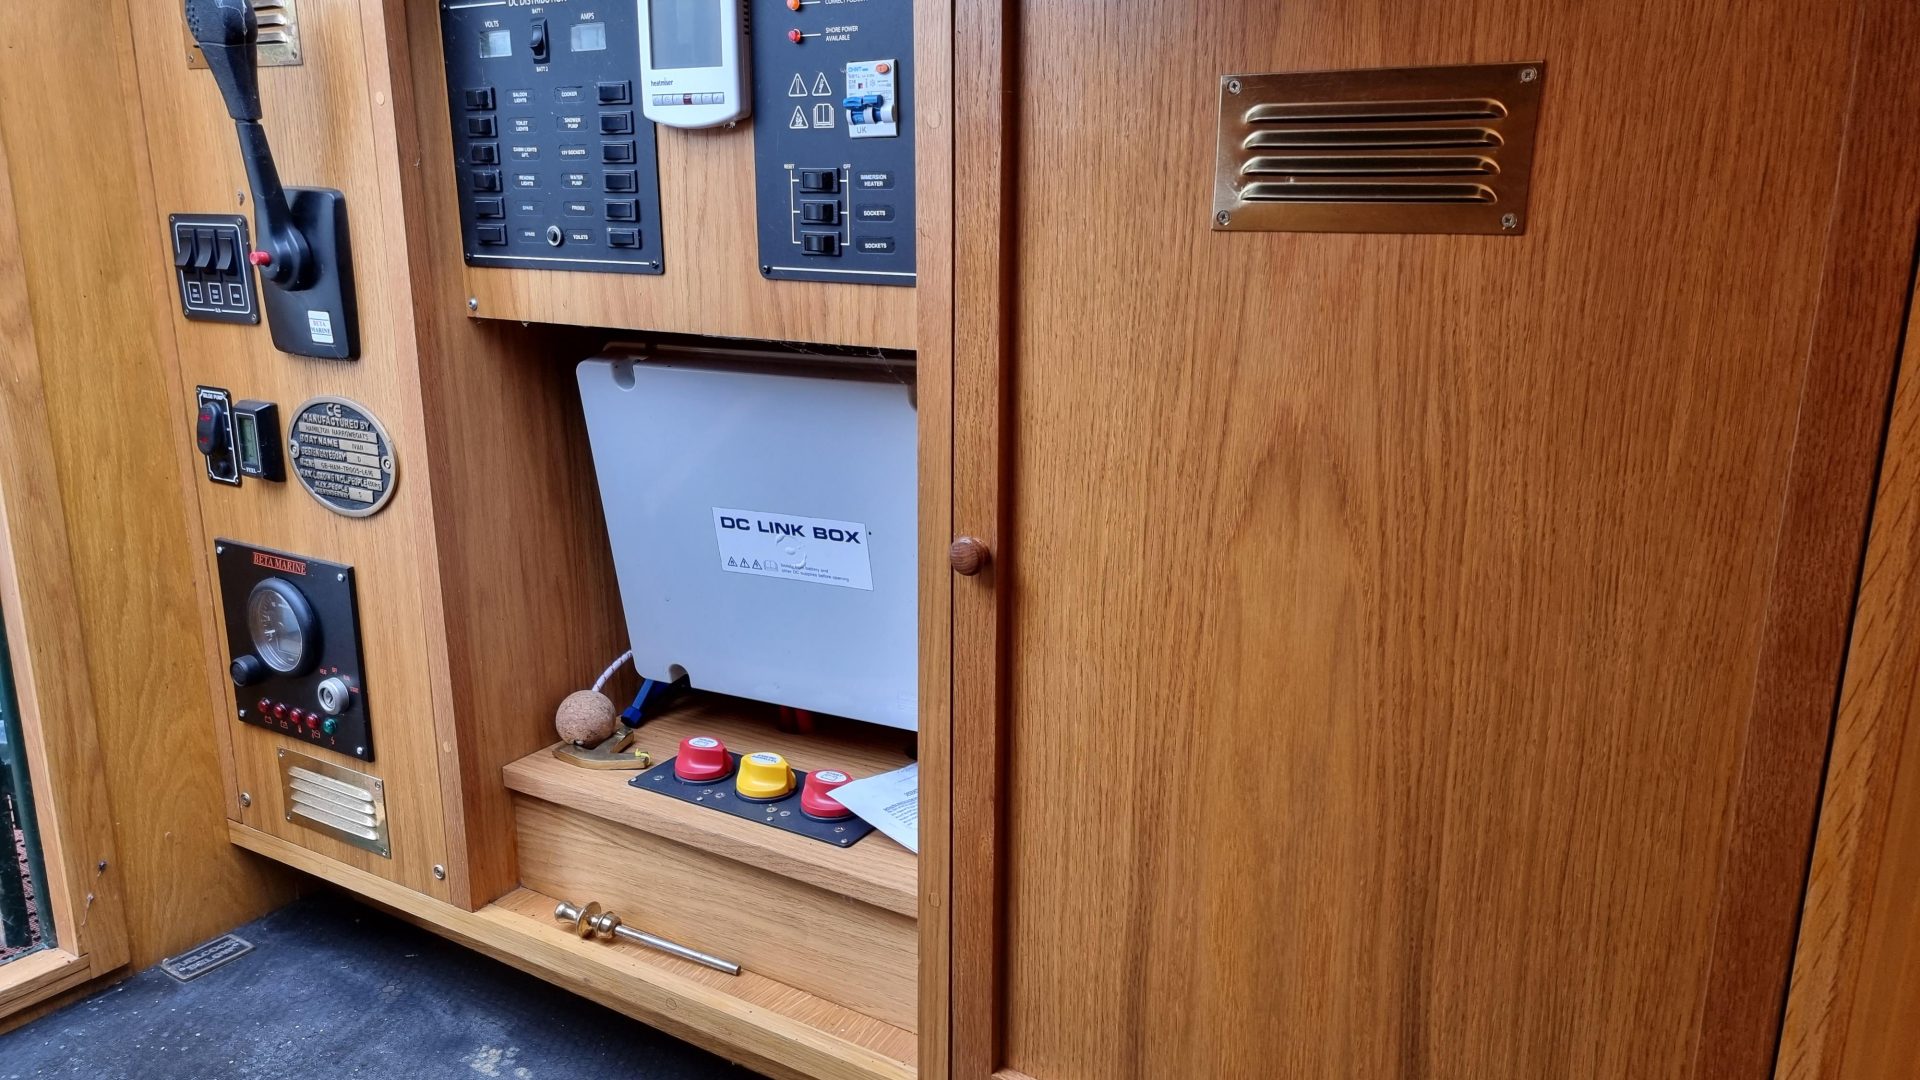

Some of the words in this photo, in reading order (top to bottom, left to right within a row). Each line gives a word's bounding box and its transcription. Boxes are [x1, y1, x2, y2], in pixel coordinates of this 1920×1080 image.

[580, 12, 595, 20] AMPS
[856, 126, 867, 134] UK
[302, 413, 359, 430] MANUFACTURED
[360, 421, 371, 431] BY
[300, 433, 317, 444] BOAT
[319, 437, 339, 448] NAME
[720, 516, 750, 531] DC
[757, 520, 806, 537] LINK
[812, 526, 861, 544] BOX
[255, 552, 273, 568] BETA
[275, 558, 306, 574] MARINE
